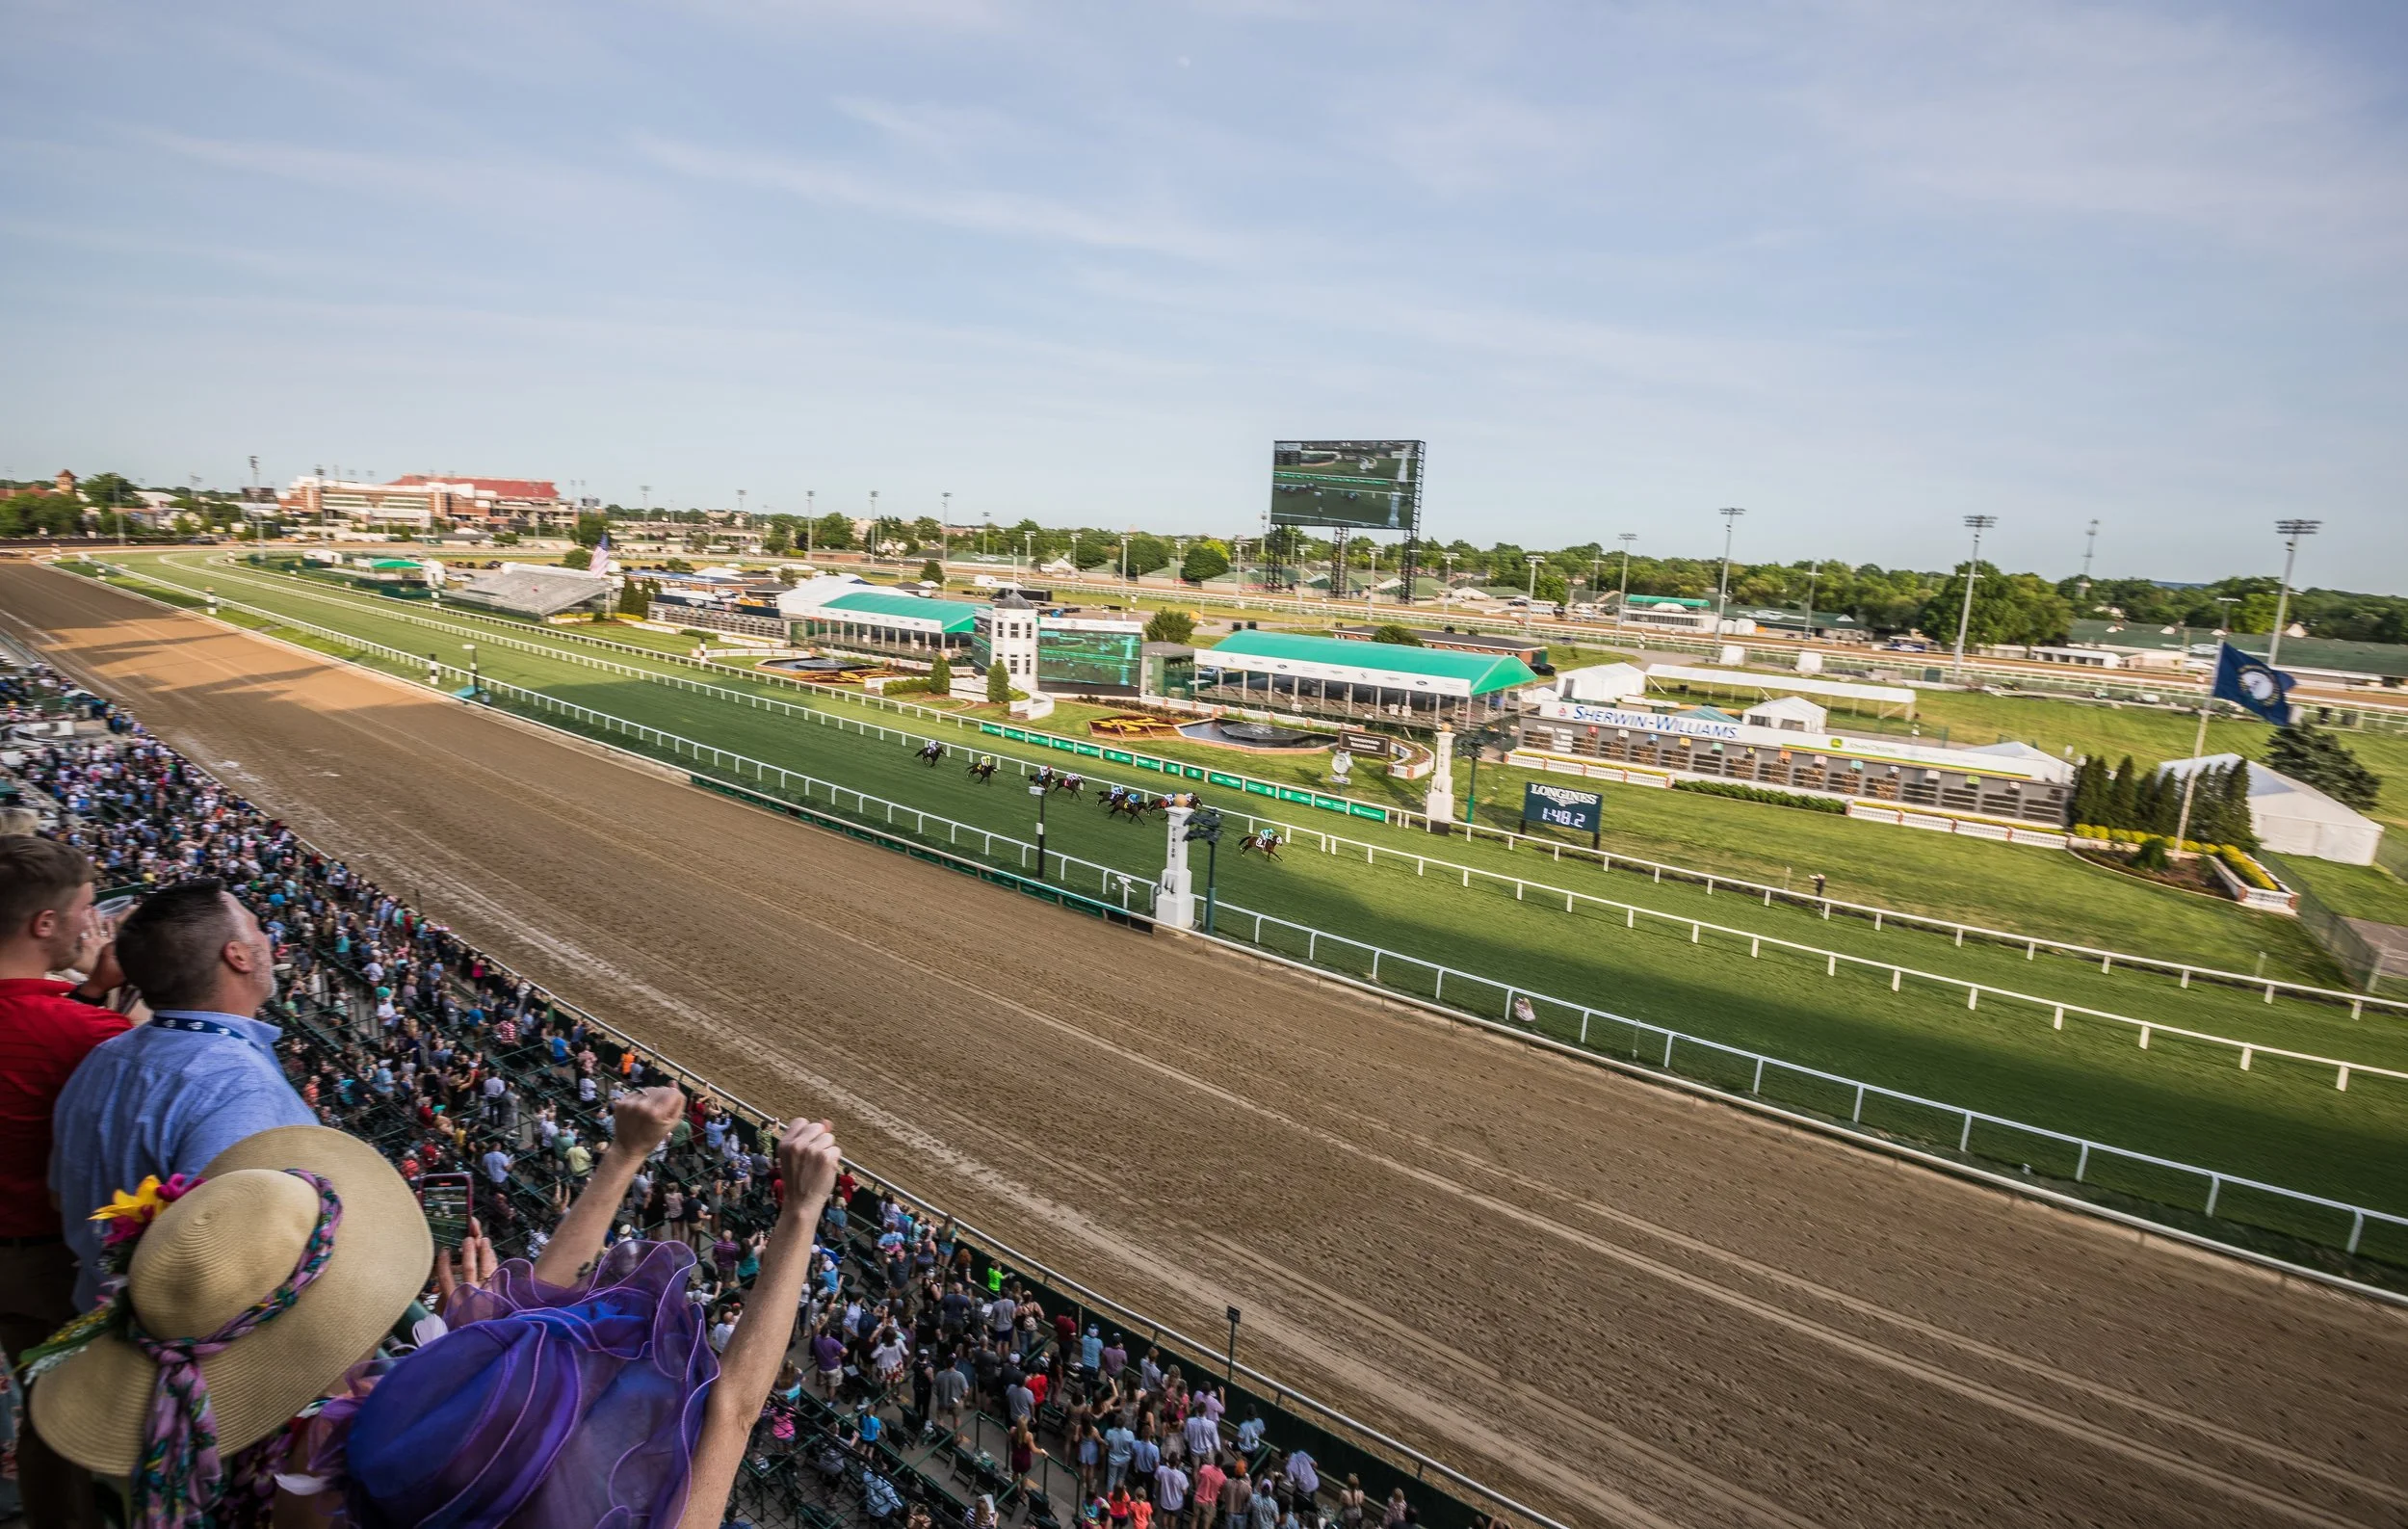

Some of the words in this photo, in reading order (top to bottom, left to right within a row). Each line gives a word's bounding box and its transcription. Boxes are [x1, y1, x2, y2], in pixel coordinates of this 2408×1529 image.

[1574, 705, 1739, 739] SHERWIN-WILLIAMS
[1531, 783, 1599, 805] LONGINES
[1542, 807, 1585, 829] 1:48.2
